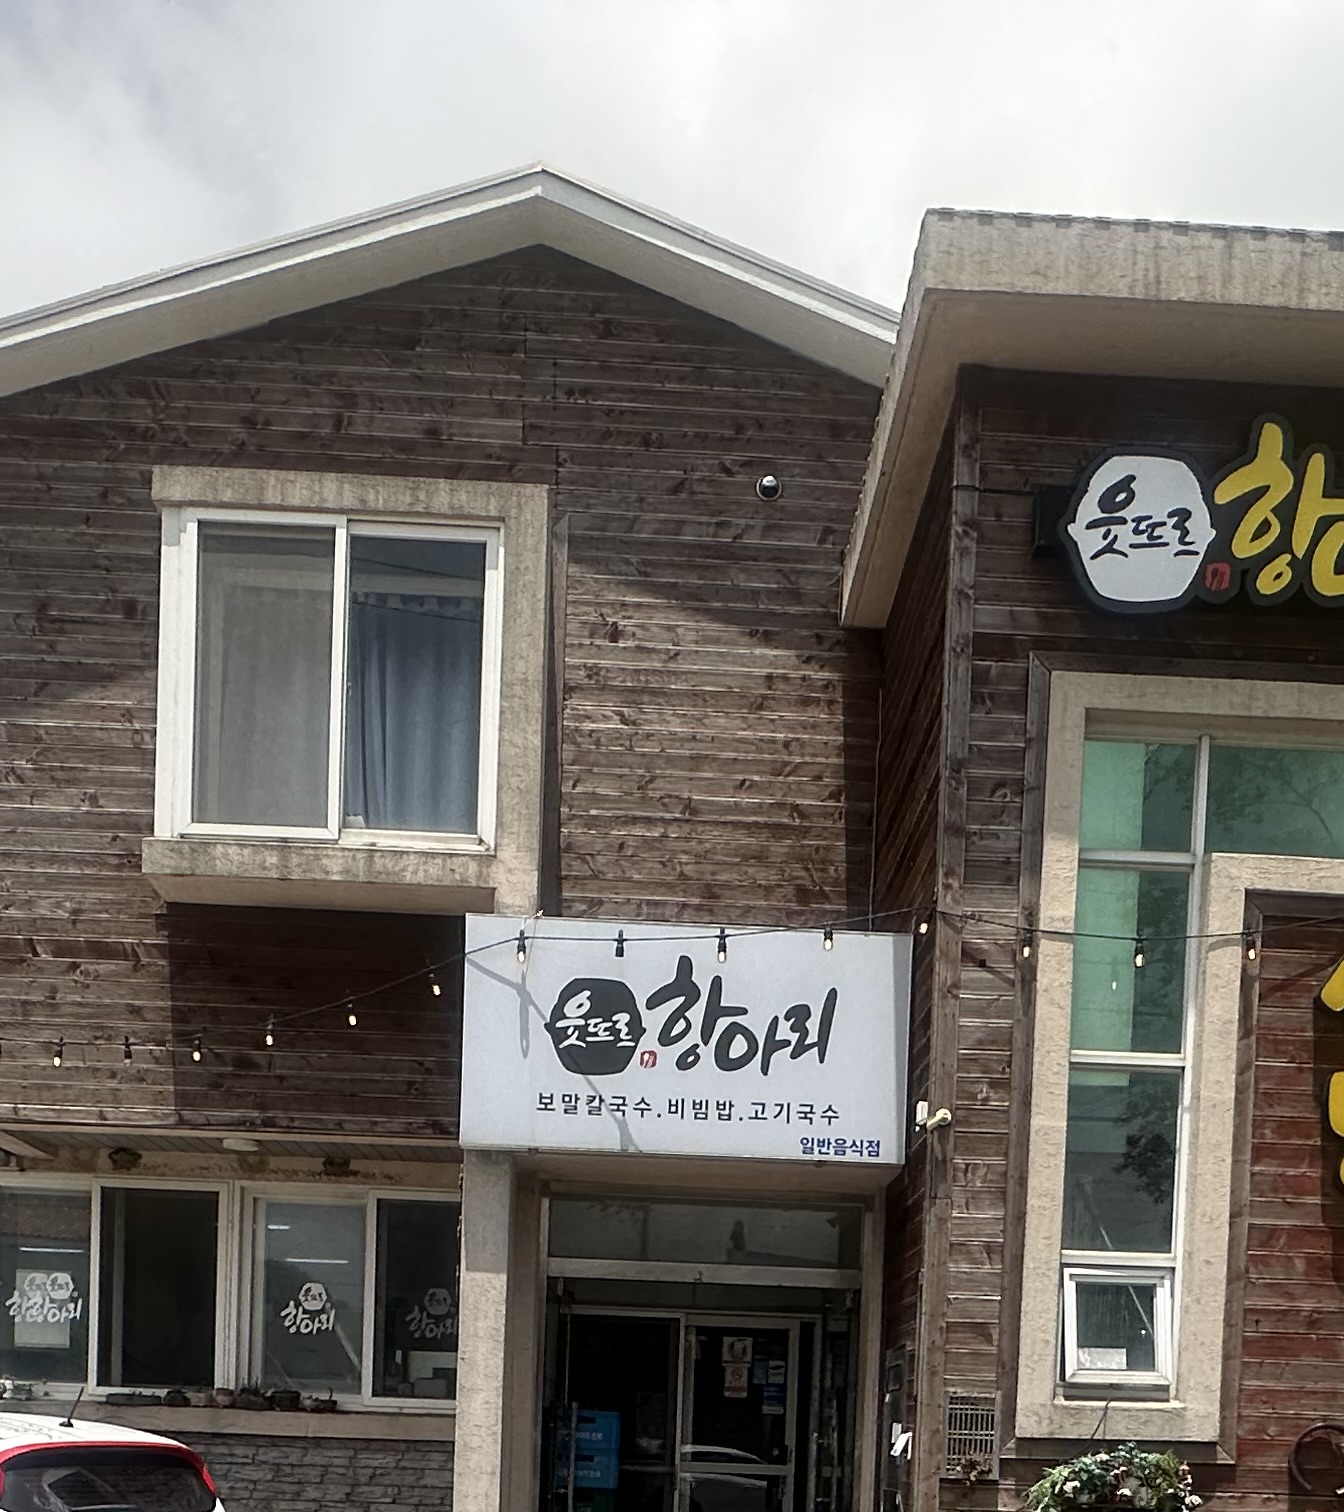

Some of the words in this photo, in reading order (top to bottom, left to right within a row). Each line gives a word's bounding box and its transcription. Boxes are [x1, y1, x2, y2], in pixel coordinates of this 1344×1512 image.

[646, 954, 838, 1076] 항아리
[799, 1136, 881, 1159] 일반음식점
[280, 1300, 336, 1335] 항아리
[405, 1305, 457, 1340] 항아리
